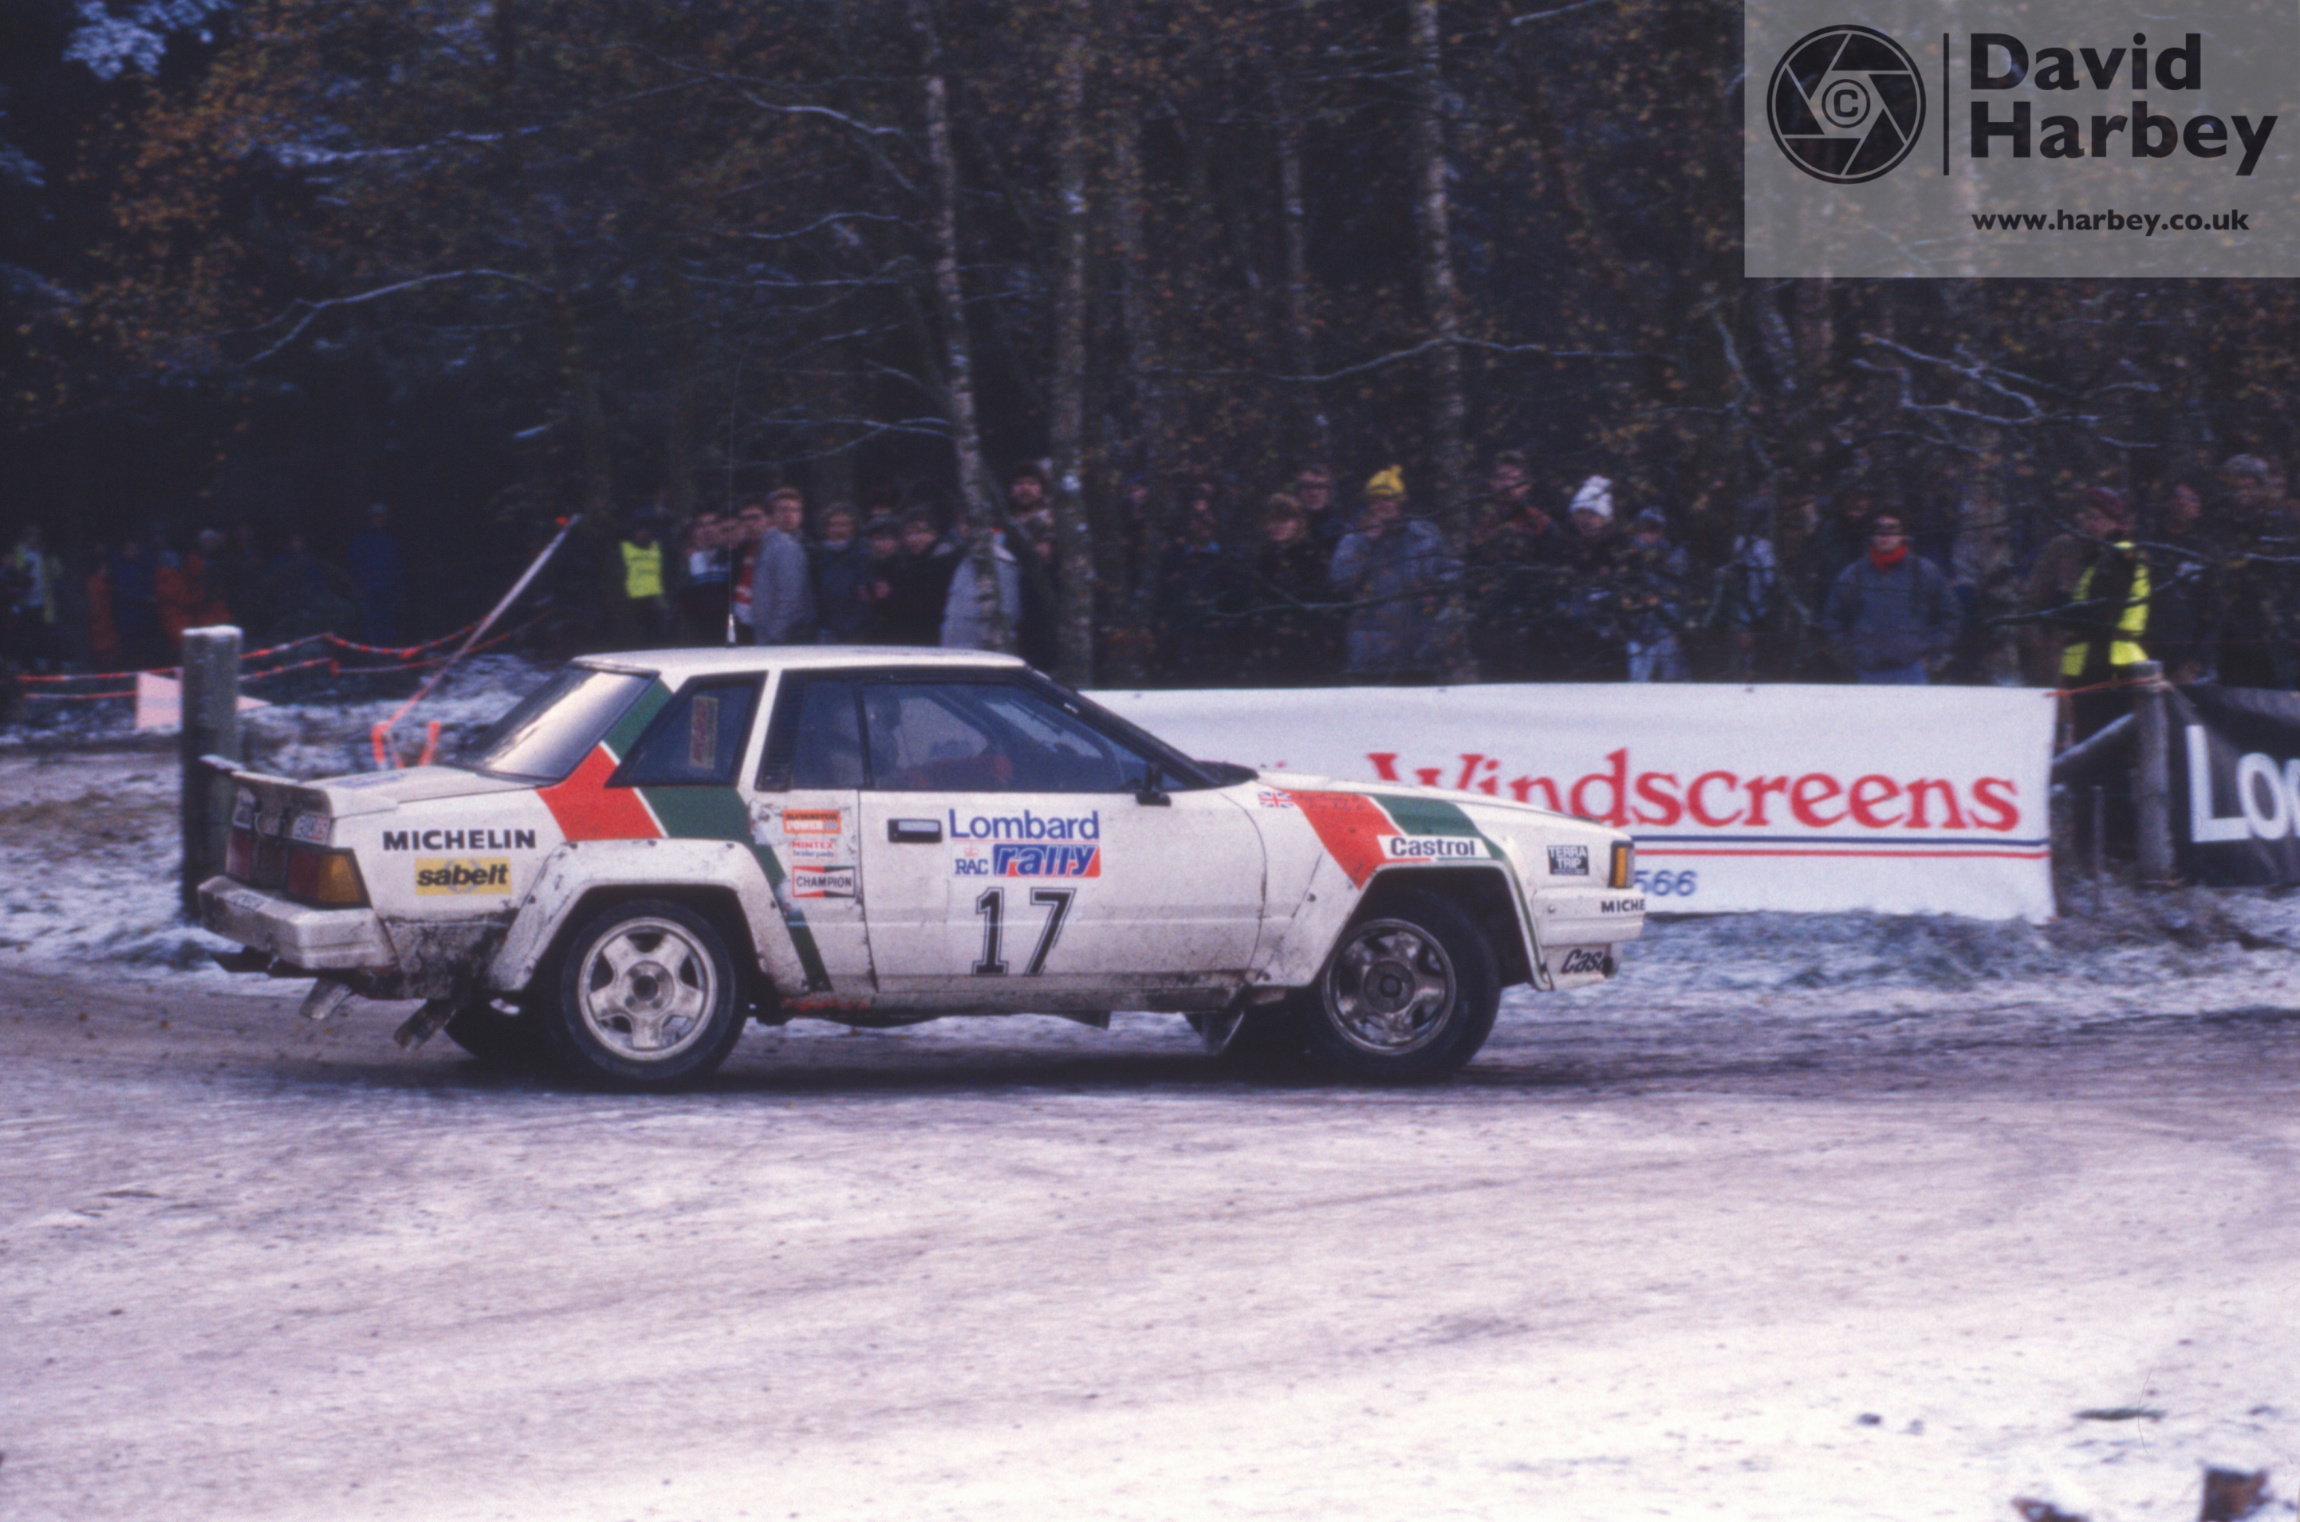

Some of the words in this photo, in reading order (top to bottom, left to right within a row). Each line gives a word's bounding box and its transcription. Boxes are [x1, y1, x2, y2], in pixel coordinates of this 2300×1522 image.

[786, 820, 824, 831] POWER
[949, 808, 1100, 839] Lombard
[383, 829, 536, 851] MICHELIN
[792, 841, 833, 849] MINTEX
[1390, 837, 1475, 856] Castrol
[955, 858, 988, 875] RAC
[996, 844, 1098, 876] rally
[1548, 846, 1587, 858] TERRA
[1555, 857, 1582, 869] TRIP
[417, 864, 508, 886] sabelt
[796, 876, 852, 887] CHAMPION
[1601, 900, 1645, 913] MICHE
[972, 887, 1077, 977] 17
[1560, 948, 1603, 974] Cas
